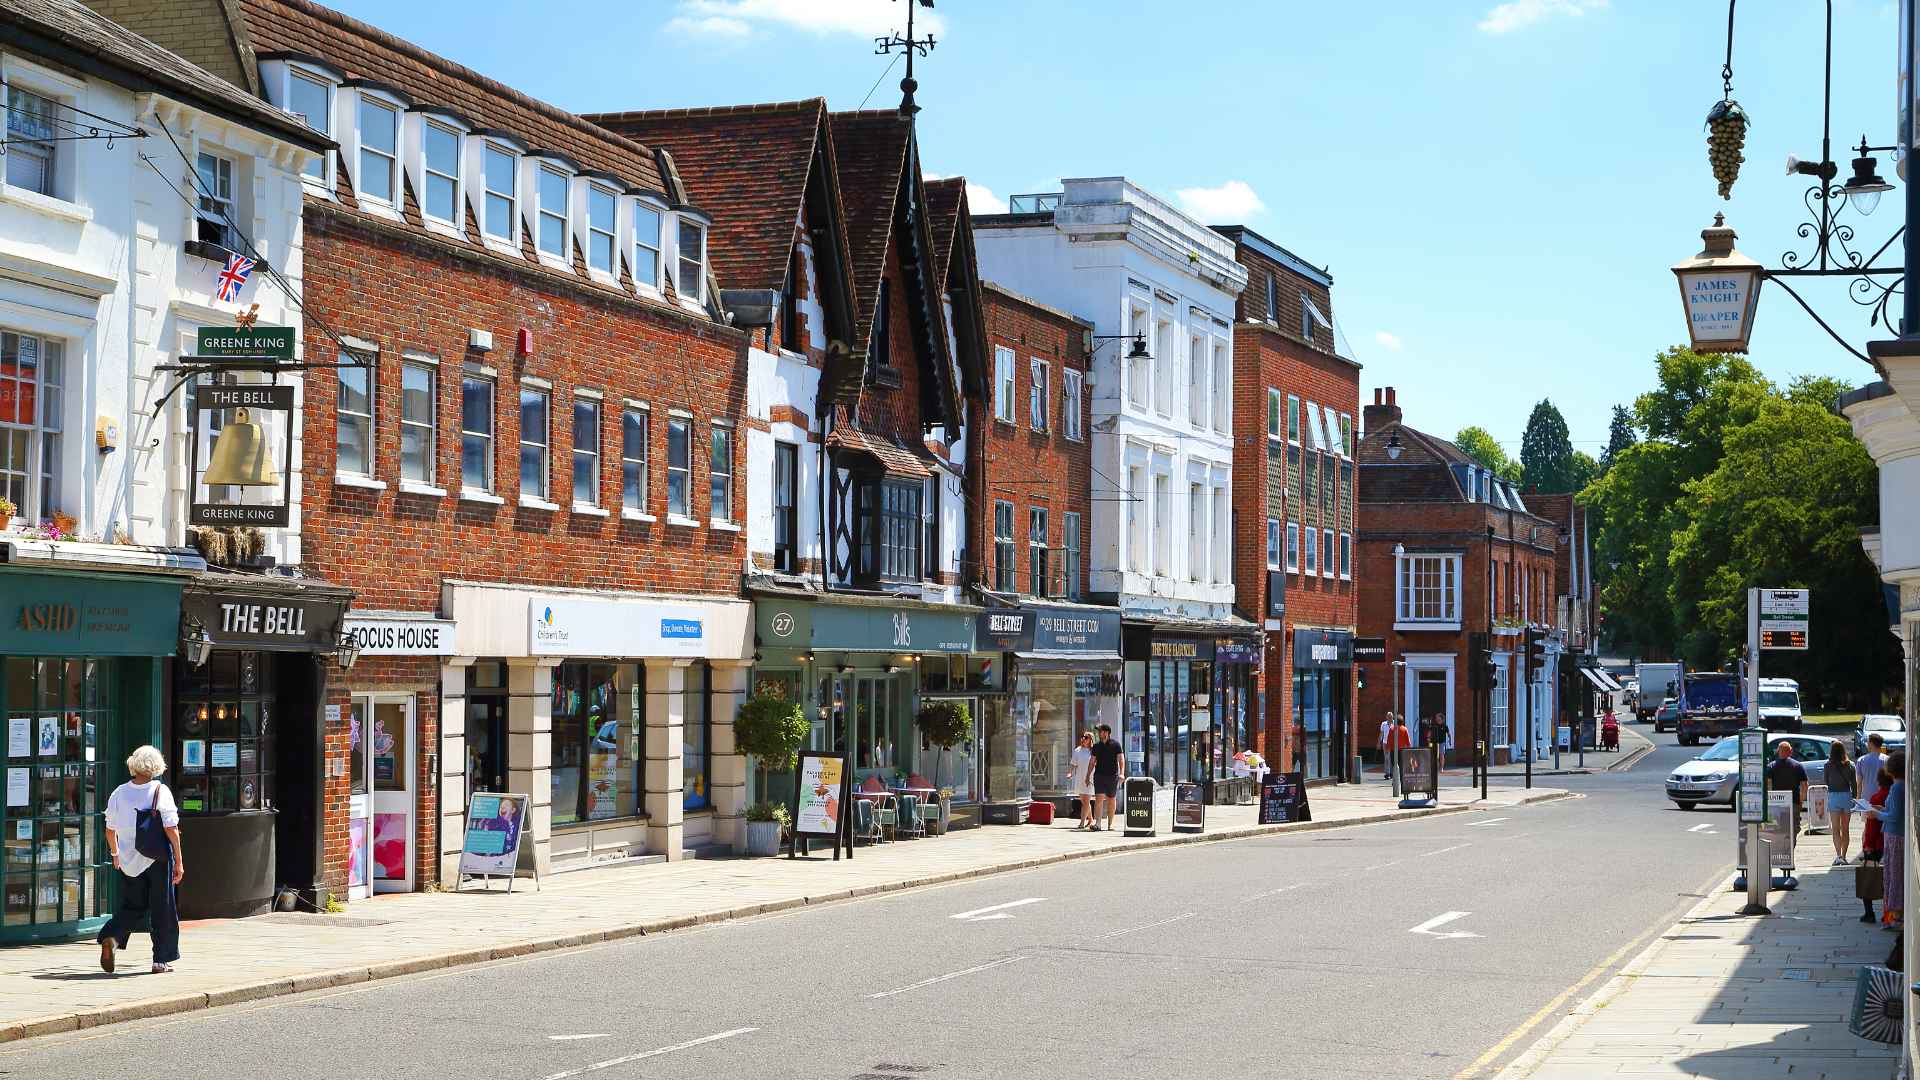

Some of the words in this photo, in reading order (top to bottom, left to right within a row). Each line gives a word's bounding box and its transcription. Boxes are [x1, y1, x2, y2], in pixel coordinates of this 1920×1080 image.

[1695, 280, 1737, 290] JAMES
[1691, 293, 1740, 304] KNIGHT
[1693, 312, 1739, 322] DRAPER
[204, 337, 250, 348] GREENE
[254, 338, 285, 348] KING
[211, 391, 239, 403] THE
[243, 392, 274, 404] BELL
[202, 508, 244, 519] GREENE
[247, 510, 275, 520] KING
[221, 603, 260, 634] THE
[263, 605, 306, 636] BELL
[775, 618, 791, 631] 27
[1053, 617, 1066, 633] BELL
[892, 612, 911, 647] Bill's
[351, 626, 394, 649] FOCUS
[397, 628, 439, 649] HOUSE
[1131, 809, 1149, 817] OPEN
